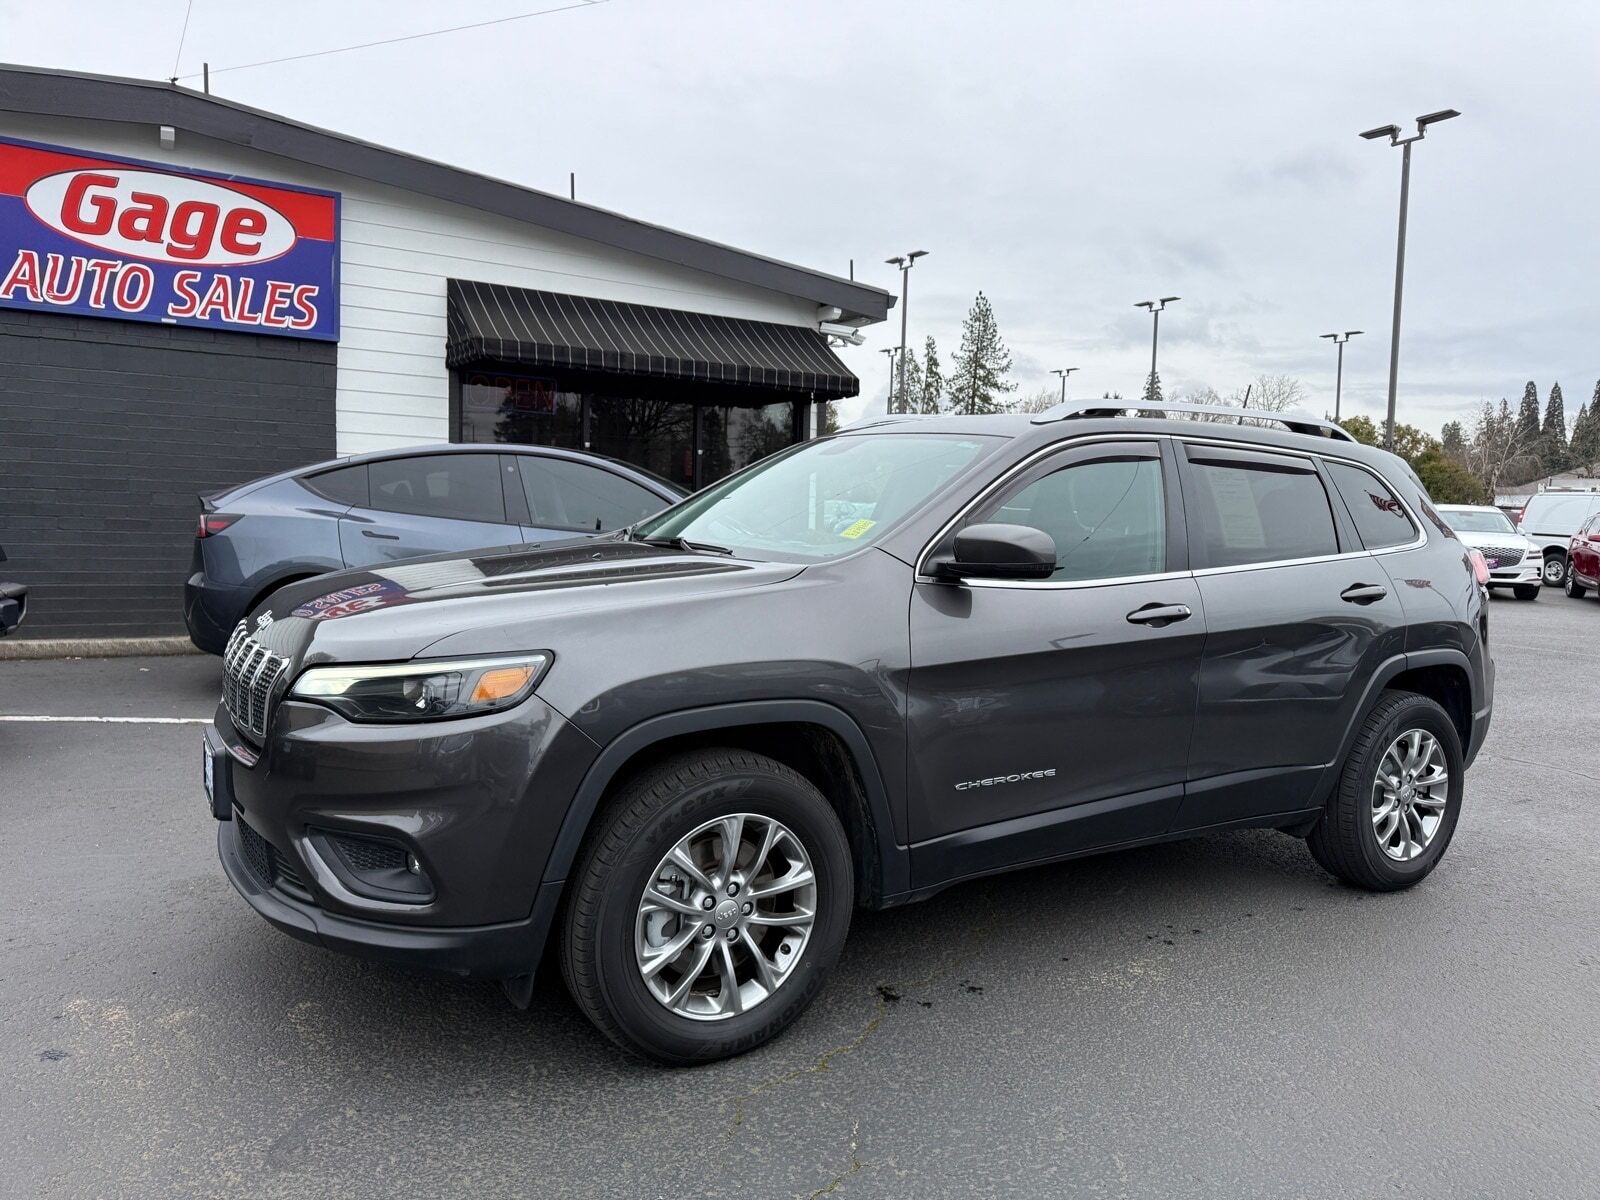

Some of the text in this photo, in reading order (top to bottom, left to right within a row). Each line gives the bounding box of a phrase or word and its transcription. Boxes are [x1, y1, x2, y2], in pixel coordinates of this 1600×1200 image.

[60, 172, 267, 260] Gage
[1, 250, 319, 330] AUTO SALES
[469, 374, 555, 411] OPEN
[955, 768, 1057, 790] CHEROKEE
[717, 907, 736, 921] Jeep
